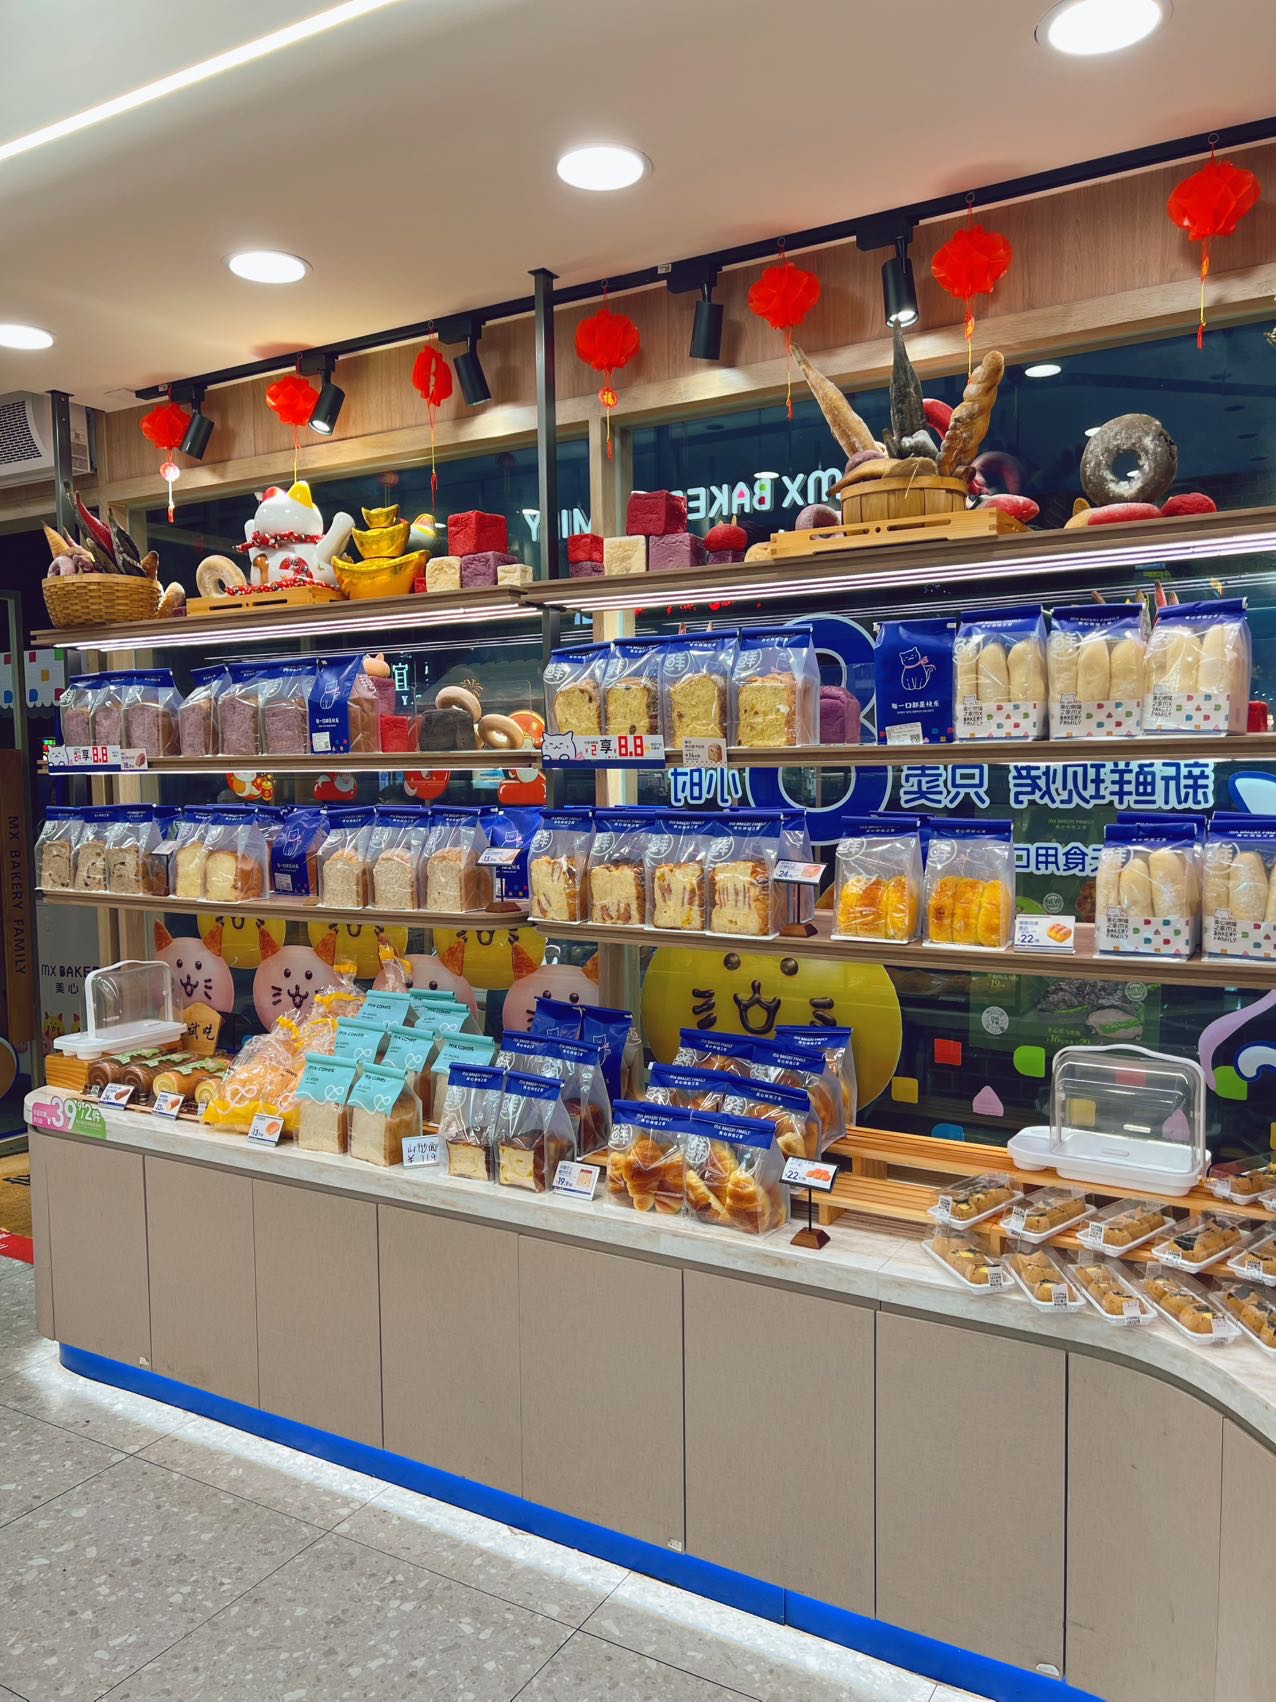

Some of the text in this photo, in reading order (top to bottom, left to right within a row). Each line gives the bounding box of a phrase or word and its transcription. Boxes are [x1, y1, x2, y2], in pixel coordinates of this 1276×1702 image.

[891, 700, 940, 710] 每一口都是快乐
[599, 739, 612, 754] 享
[617, 736, 644, 757] 8.8
[81, 749, 90, 761] 享
[92, 747, 109, 763] 8.8
[8, 815, 27, 976] MX BAKERY FAMILY
[41, 964, 57, 977] MX
[55, 982, 80, 995] 美心
